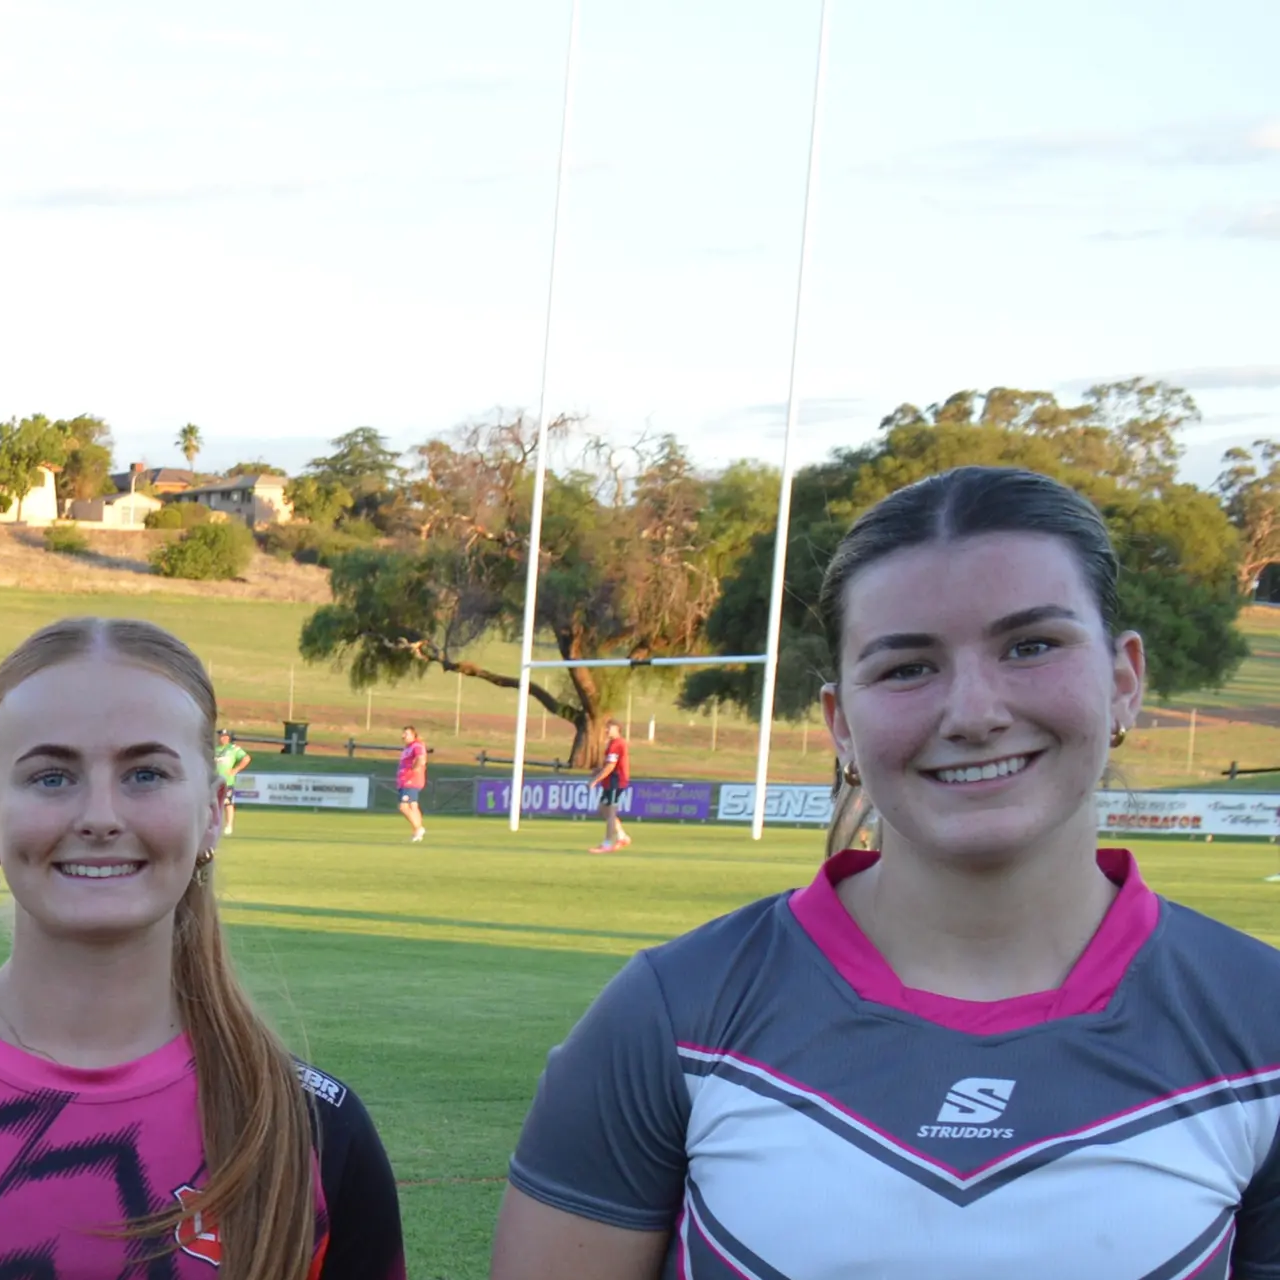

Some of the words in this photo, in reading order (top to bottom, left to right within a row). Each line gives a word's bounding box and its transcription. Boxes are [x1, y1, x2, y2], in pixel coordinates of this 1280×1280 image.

[502, 784, 544, 810] 100
[548, 785, 633, 812] BUGMN
[917, 1125, 1015, 1139] STRUDDYS
